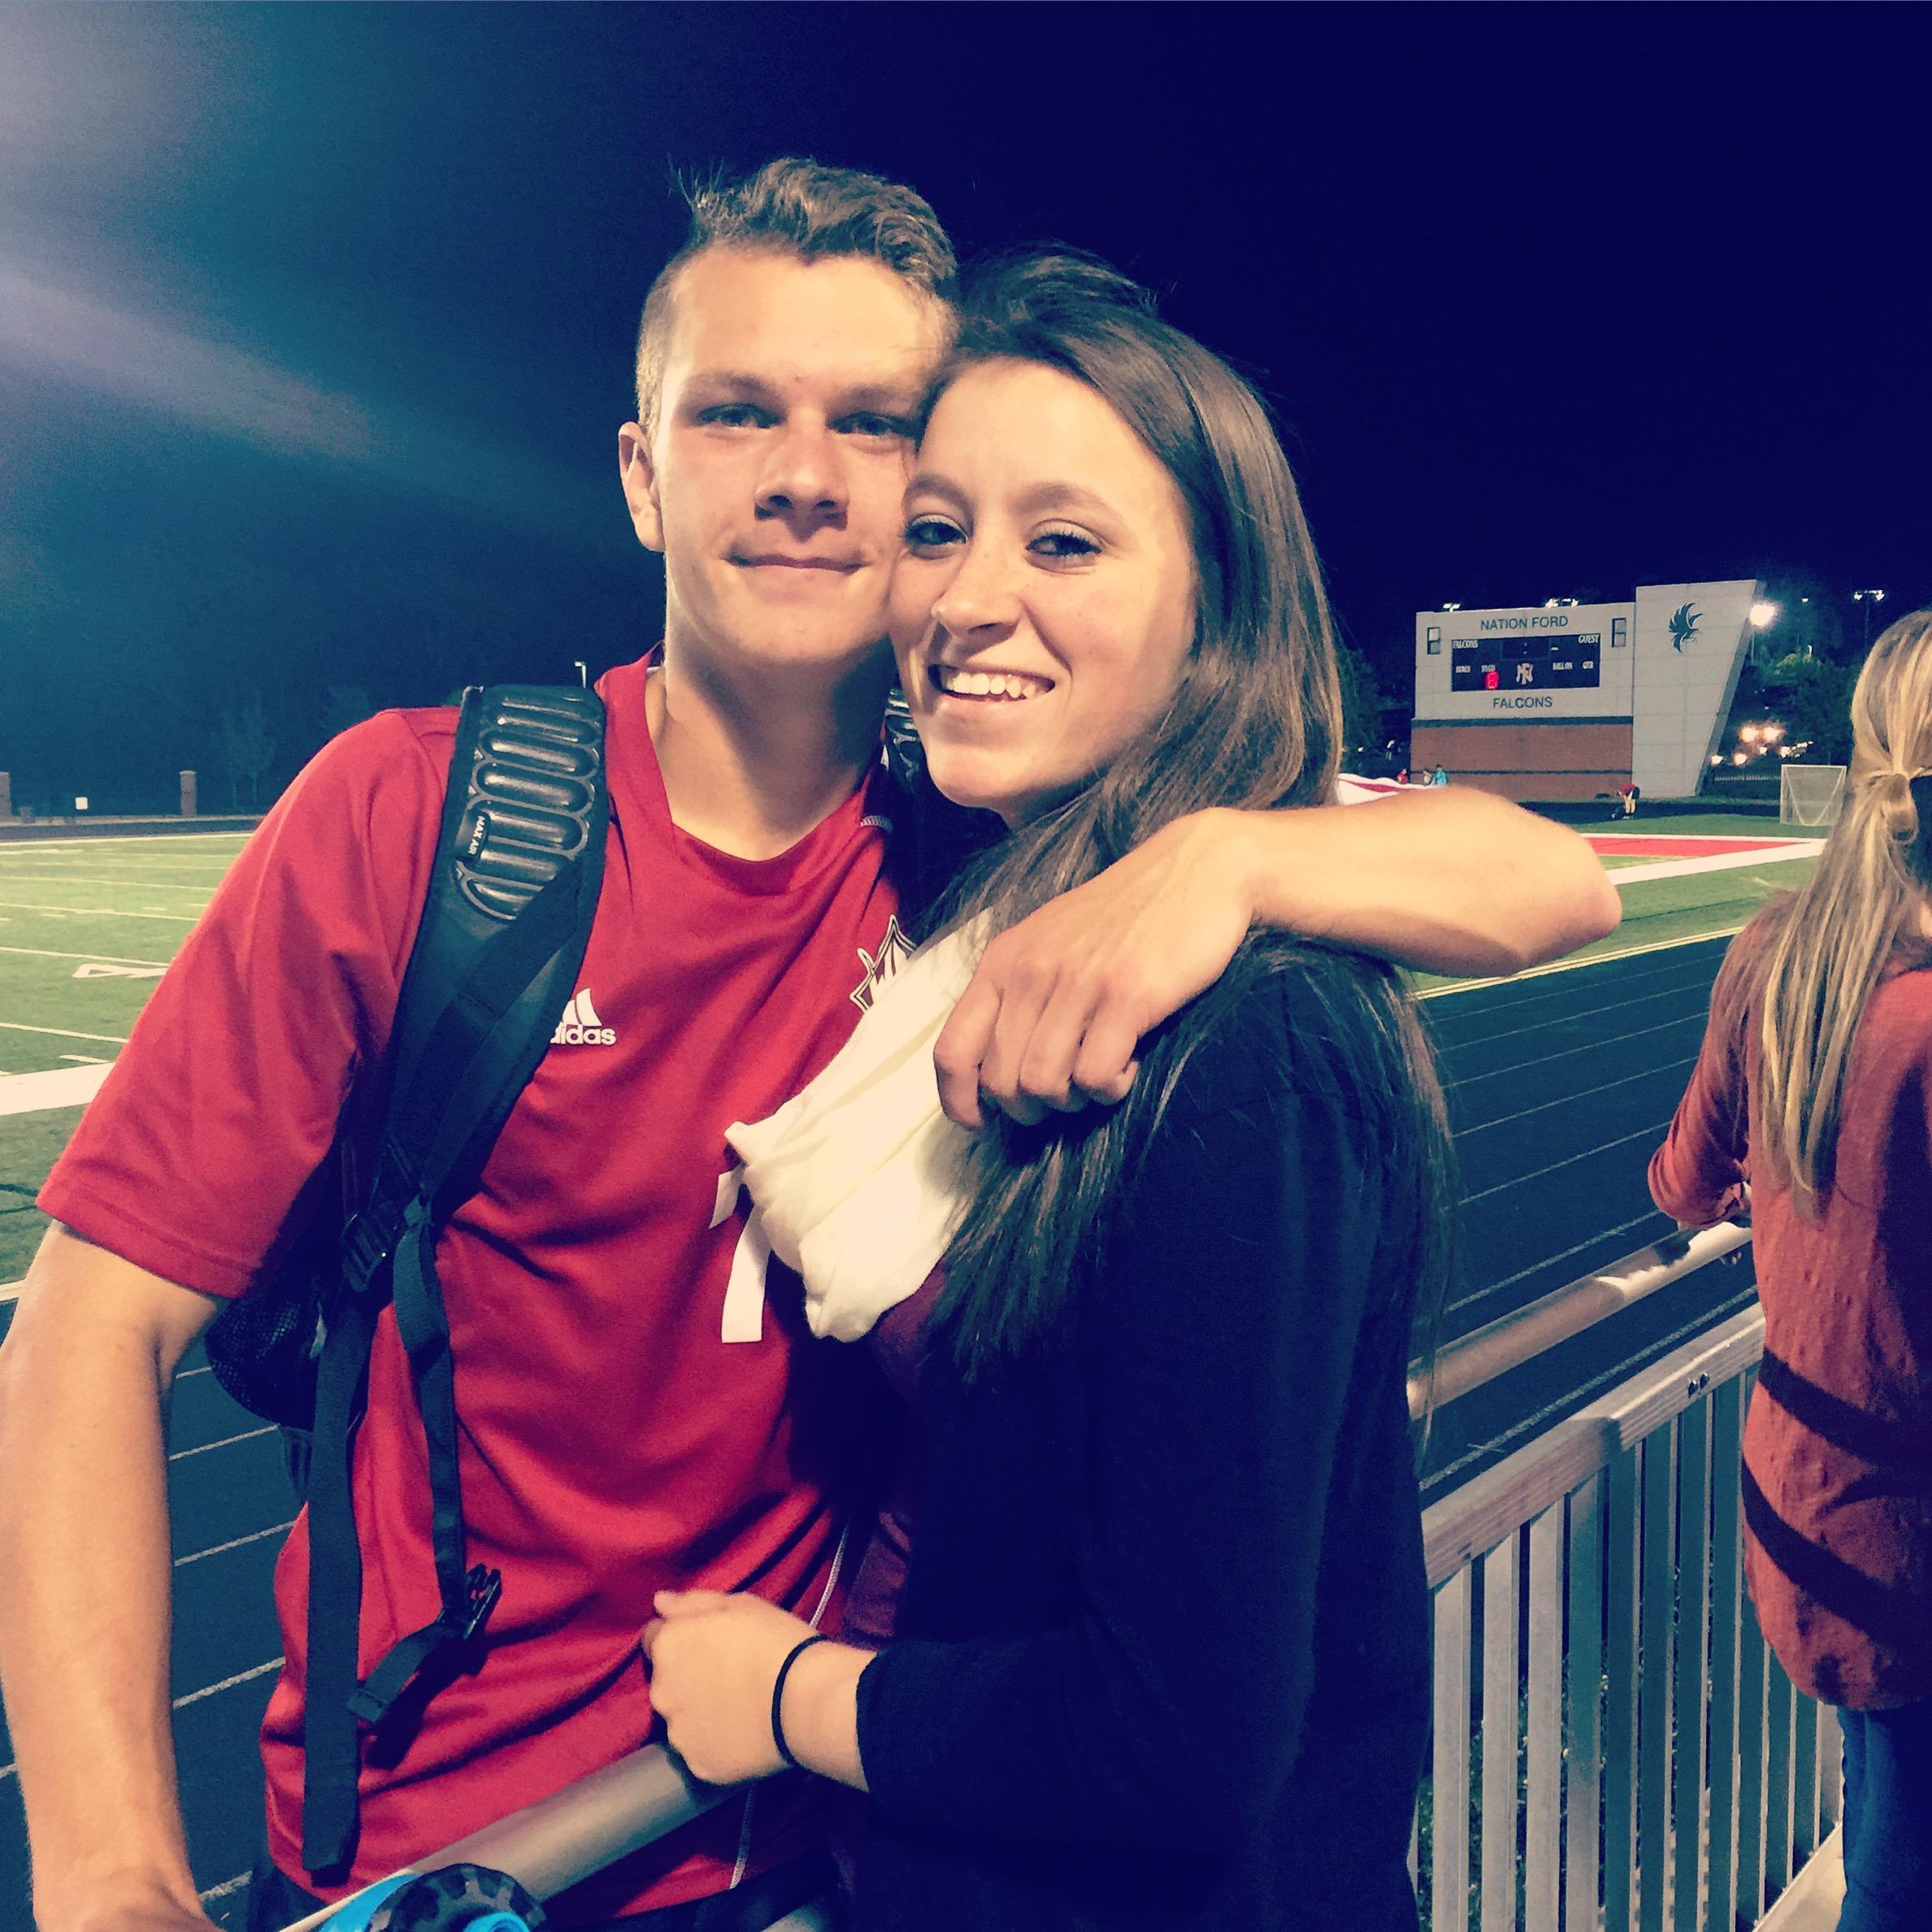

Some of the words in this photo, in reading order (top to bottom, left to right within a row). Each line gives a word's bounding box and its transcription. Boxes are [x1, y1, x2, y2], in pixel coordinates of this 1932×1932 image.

[1480, 618, 1528, 631] NATION
[1532, 615, 1569, 628] FORD
[1452, 640, 1478, 649] FALCONS
[1578, 634, 1600, 644] GUEST
[1493, 696, 1553, 709] FALCONS
[473, 815, 486, 839] MAX
[550, 1021, 617, 1045] didas
